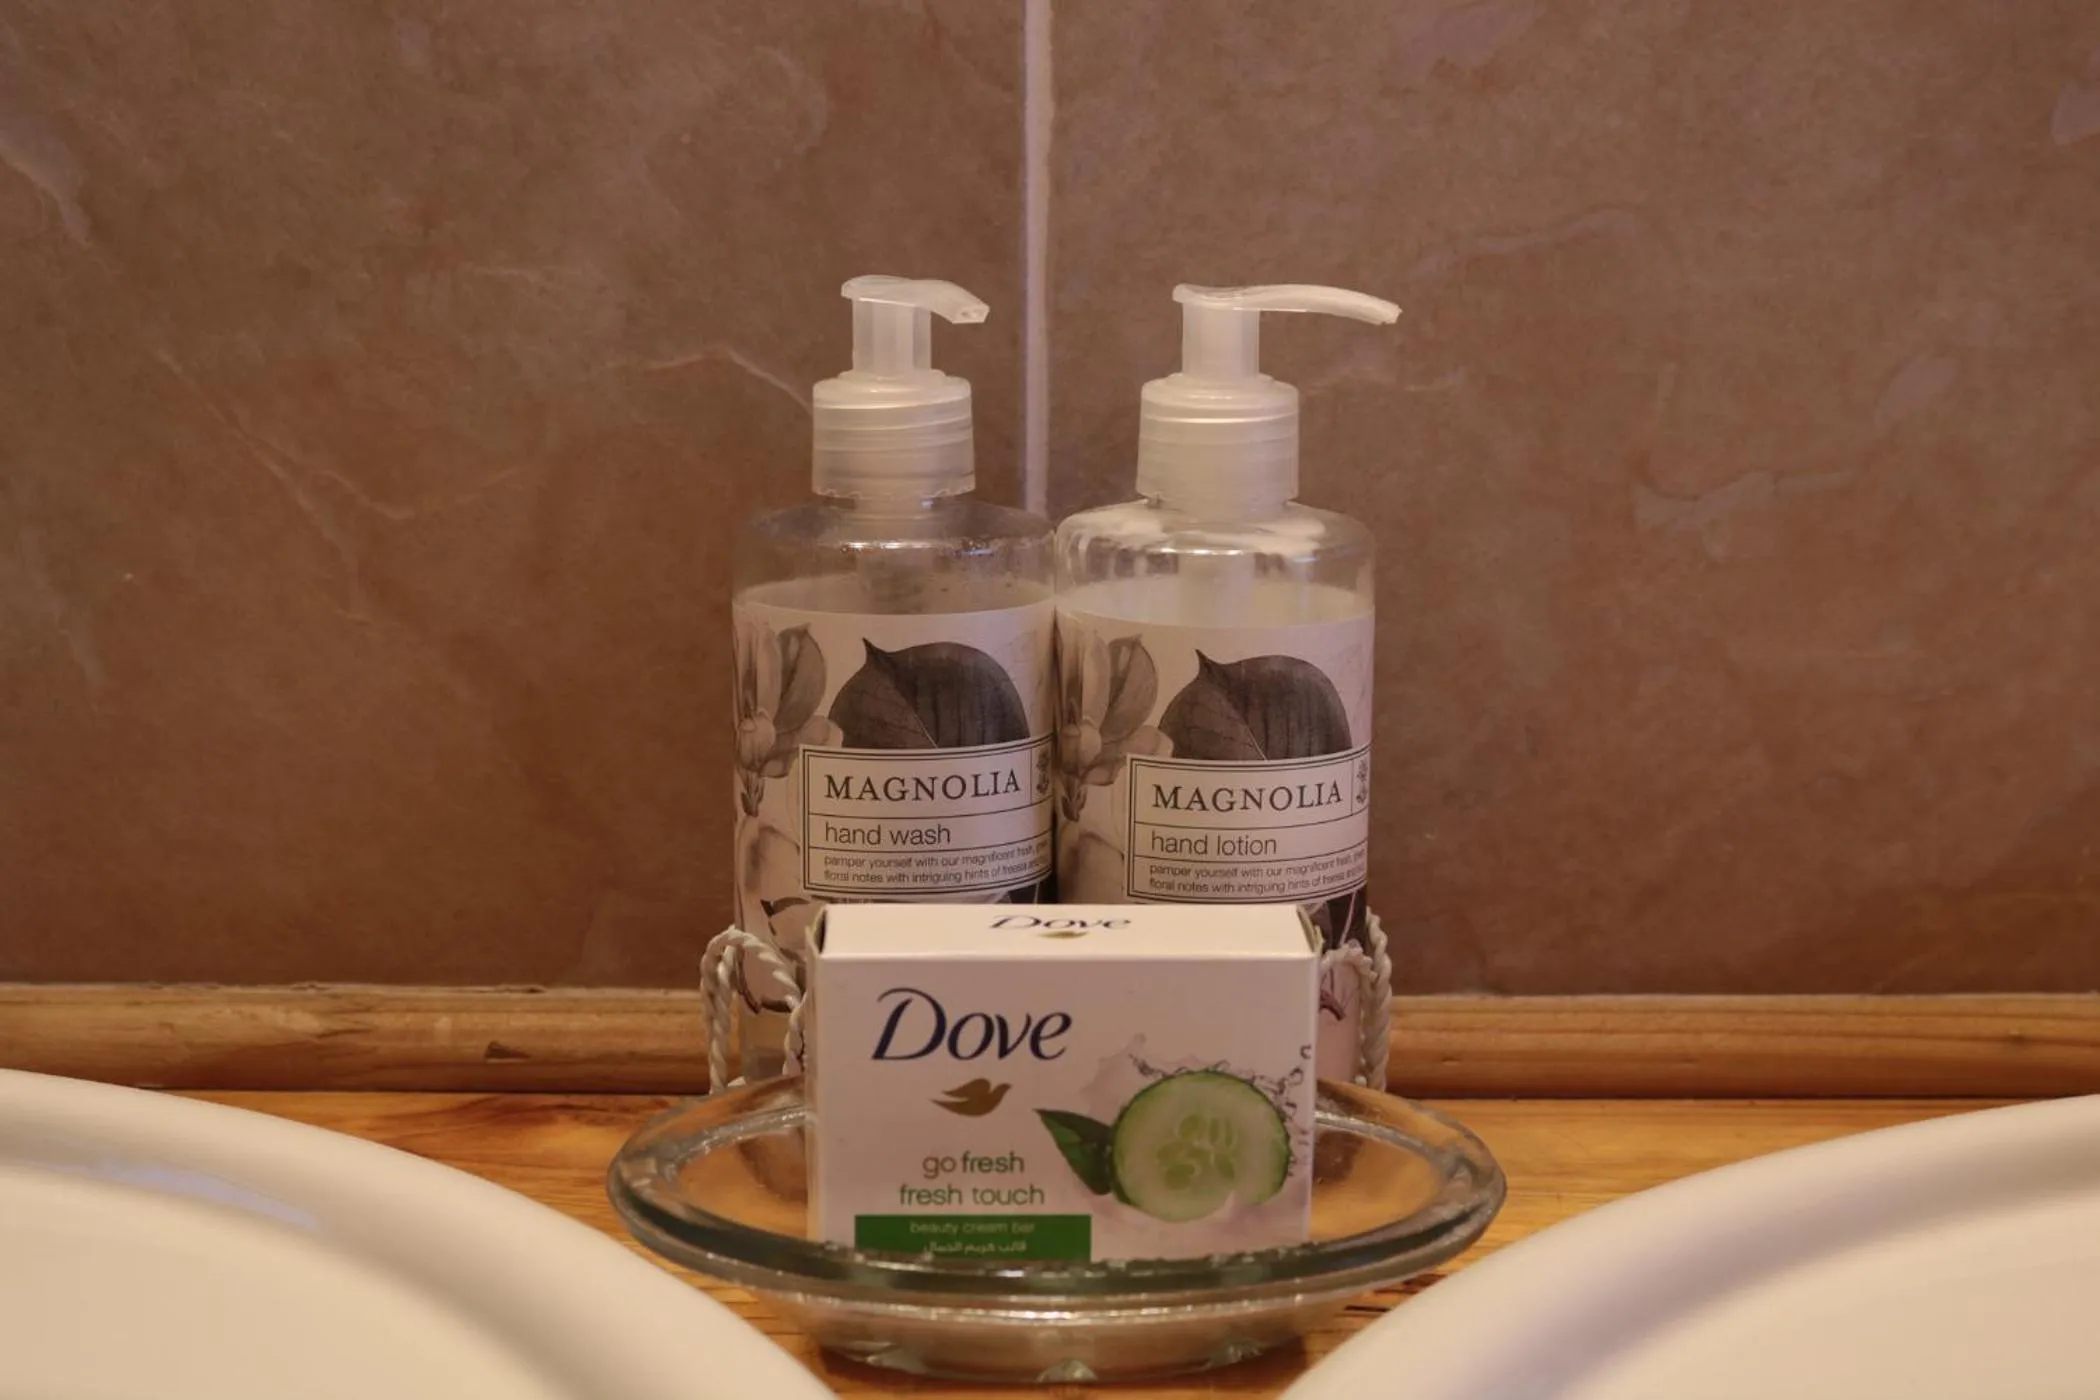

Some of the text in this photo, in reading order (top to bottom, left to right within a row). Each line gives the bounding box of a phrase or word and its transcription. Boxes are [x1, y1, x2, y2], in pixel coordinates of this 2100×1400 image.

[824, 769, 1020, 801] MAGNOLIA
[1152, 780, 1343, 813] MAGNOLIA
[825, 822, 951, 846] hand wash
[1151, 830, 1277, 856] hand lotion
[824, 855, 865, 869] pamper
[869, 857, 912, 869] yourself
[915, 856, 938, 868] with
[941, 856, 960, 867] our
[1149, 864, 1191, 877] pamper
[1194, 867, 1238, 880] yourself
[1240, 866, 1263, 878] with
[1266, 867, 1282, 878] our
[824, 870, 849, 881] floral
[852, 872, 883, 883] notes
[885, 872, 909, 883] with
[912, 870, 962, 885] intriguing
[965, 867, 990, 880] hints
[991, 865, 1001, 878] of
[1149, 876, 1175, 890] floral
[1178, 881, 1208, 893] notes
[1211, 882, 1234, 894] with
[1237, 880, 1286, 895] intriguing
[1287, 878, 1310, 891] hints
[1312, 875, 1321, 888] of
[990, 914, 1132, 930] Dove
[871, 987, 1073, 1062] Dove
[922, 1151, 1025, 1180] go fresh
[899, 1183, 1046, 1206] fresh touch
[909, 1221, 1036, 1236] beauty cream bar
